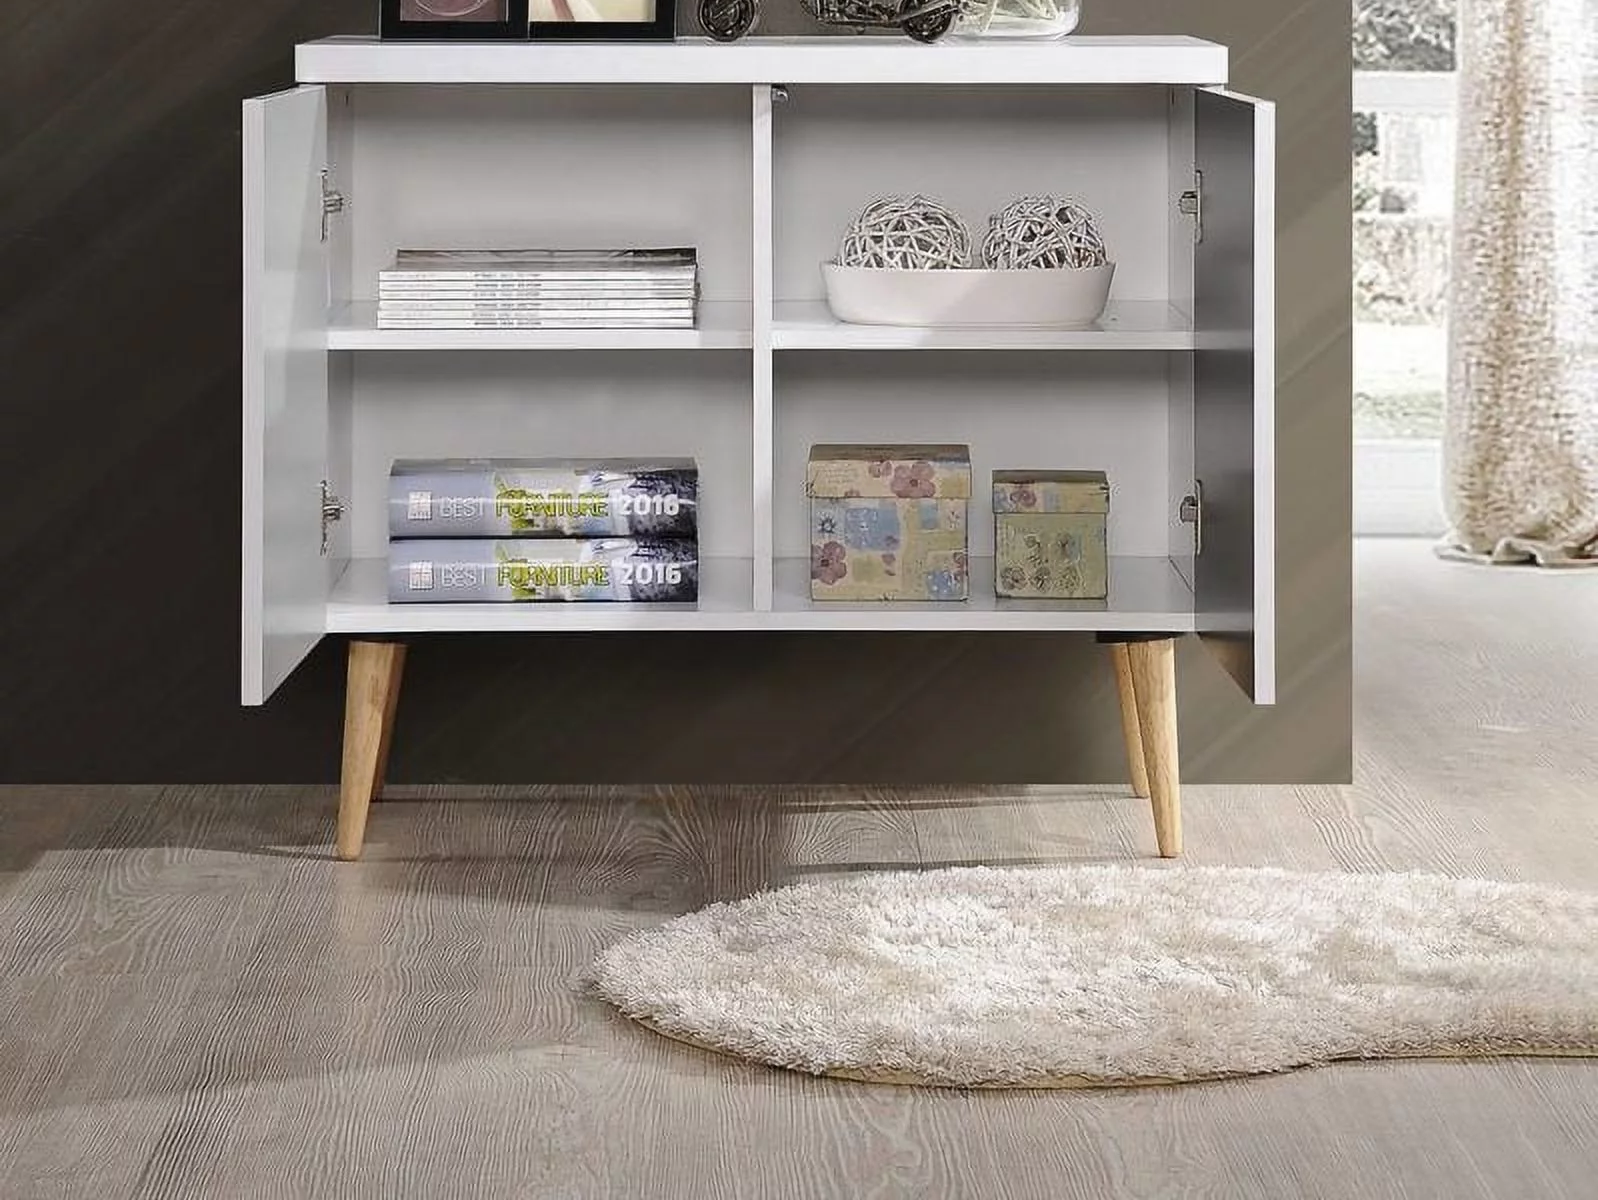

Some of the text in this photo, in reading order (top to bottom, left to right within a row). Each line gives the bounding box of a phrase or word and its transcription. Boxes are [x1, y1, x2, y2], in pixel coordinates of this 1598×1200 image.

[440, 493, 680, 518] BEST FURNITURE 2016
[441, 563, 682, 587] BEST FURNITURE 2016
